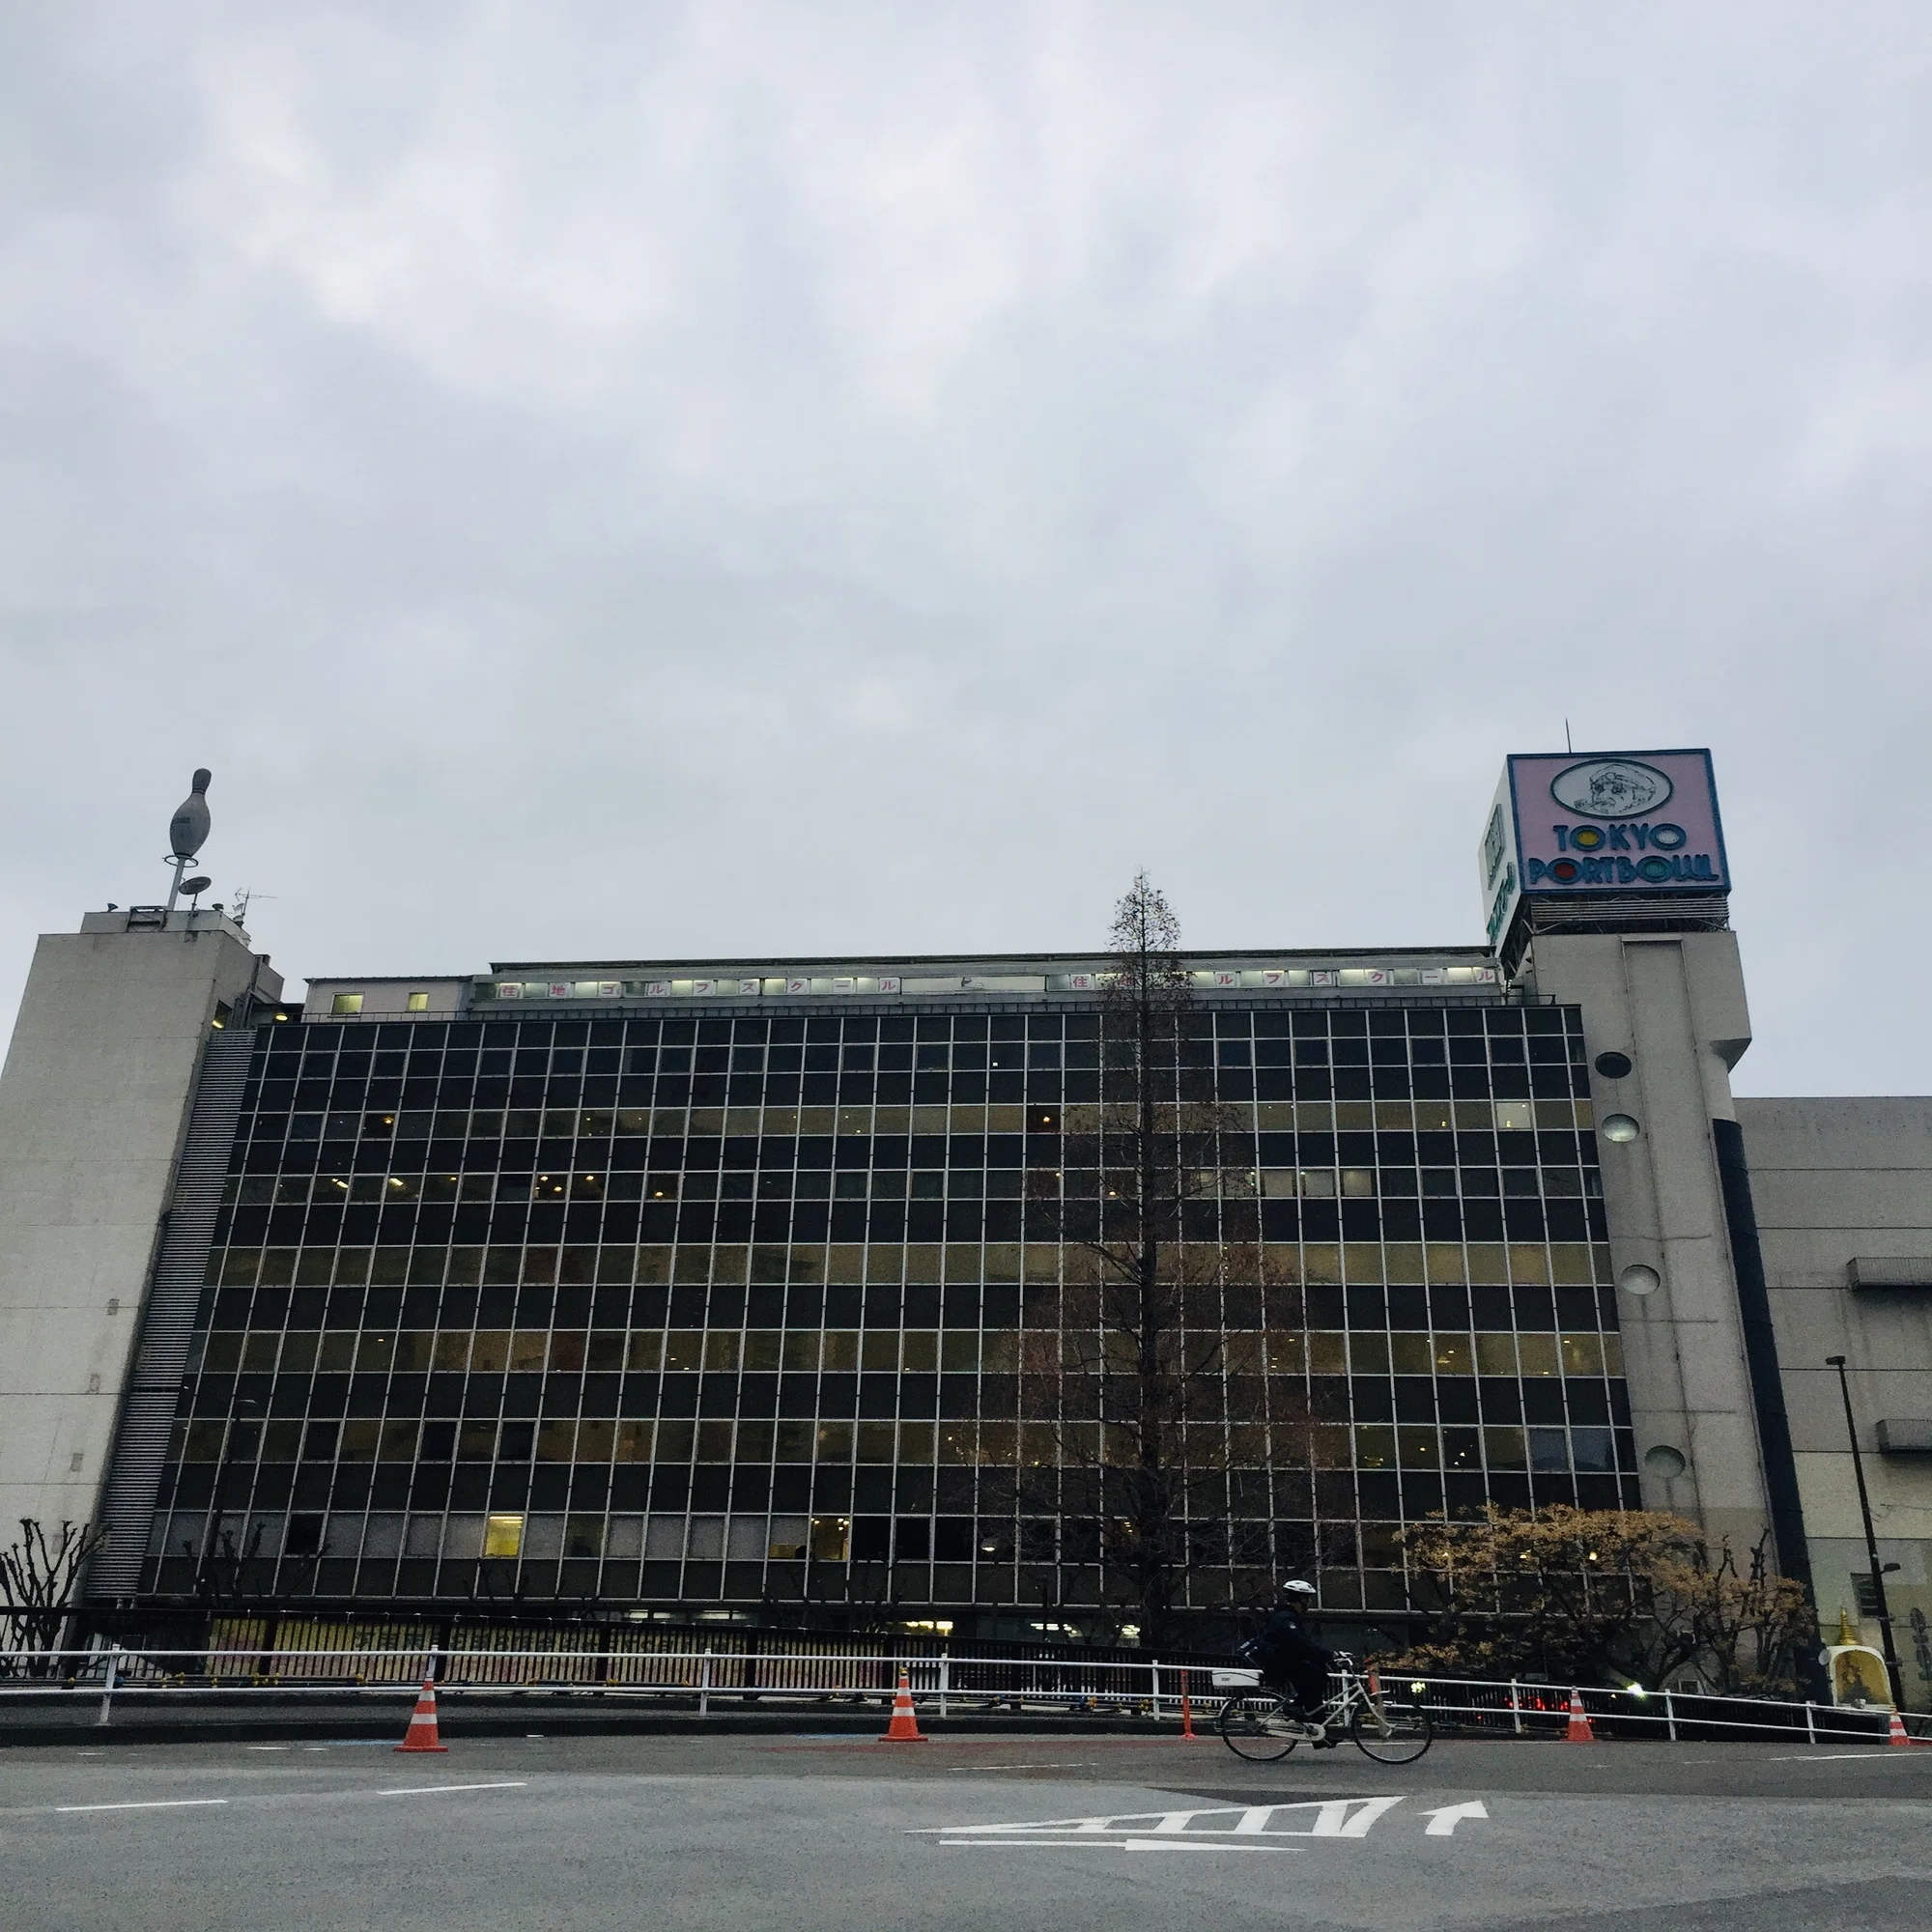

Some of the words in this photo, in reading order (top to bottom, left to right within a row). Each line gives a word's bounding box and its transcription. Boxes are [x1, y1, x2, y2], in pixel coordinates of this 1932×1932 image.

[1552, 823, 1687, 851] TOKYO
[1528, 855, 1719, 884] PORTBOWL
[1072, 970, 1493, 987] 住ルフスクール
